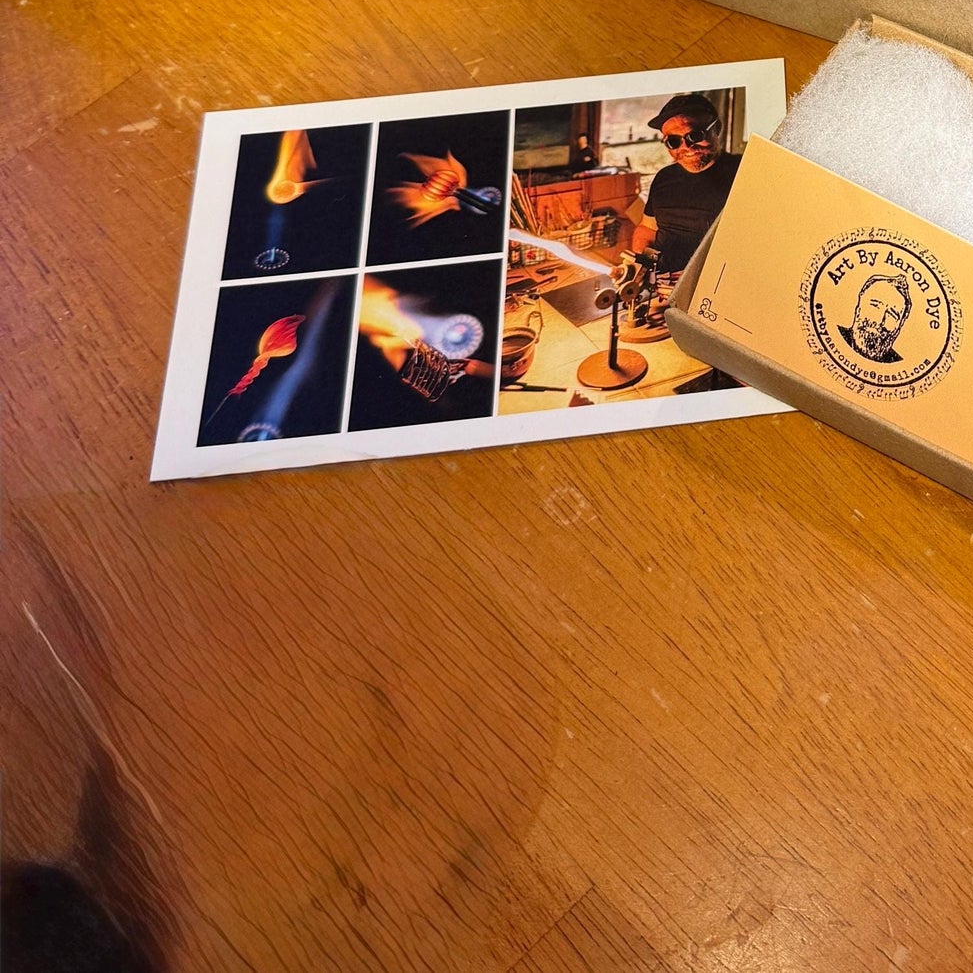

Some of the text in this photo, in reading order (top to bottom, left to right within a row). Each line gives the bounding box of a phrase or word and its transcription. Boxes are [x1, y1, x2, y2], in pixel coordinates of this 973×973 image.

[827, 249, 941, 330] Art By Aaron Dye
[815, 302, 932, 383] artbyaarondye@gmail.com
